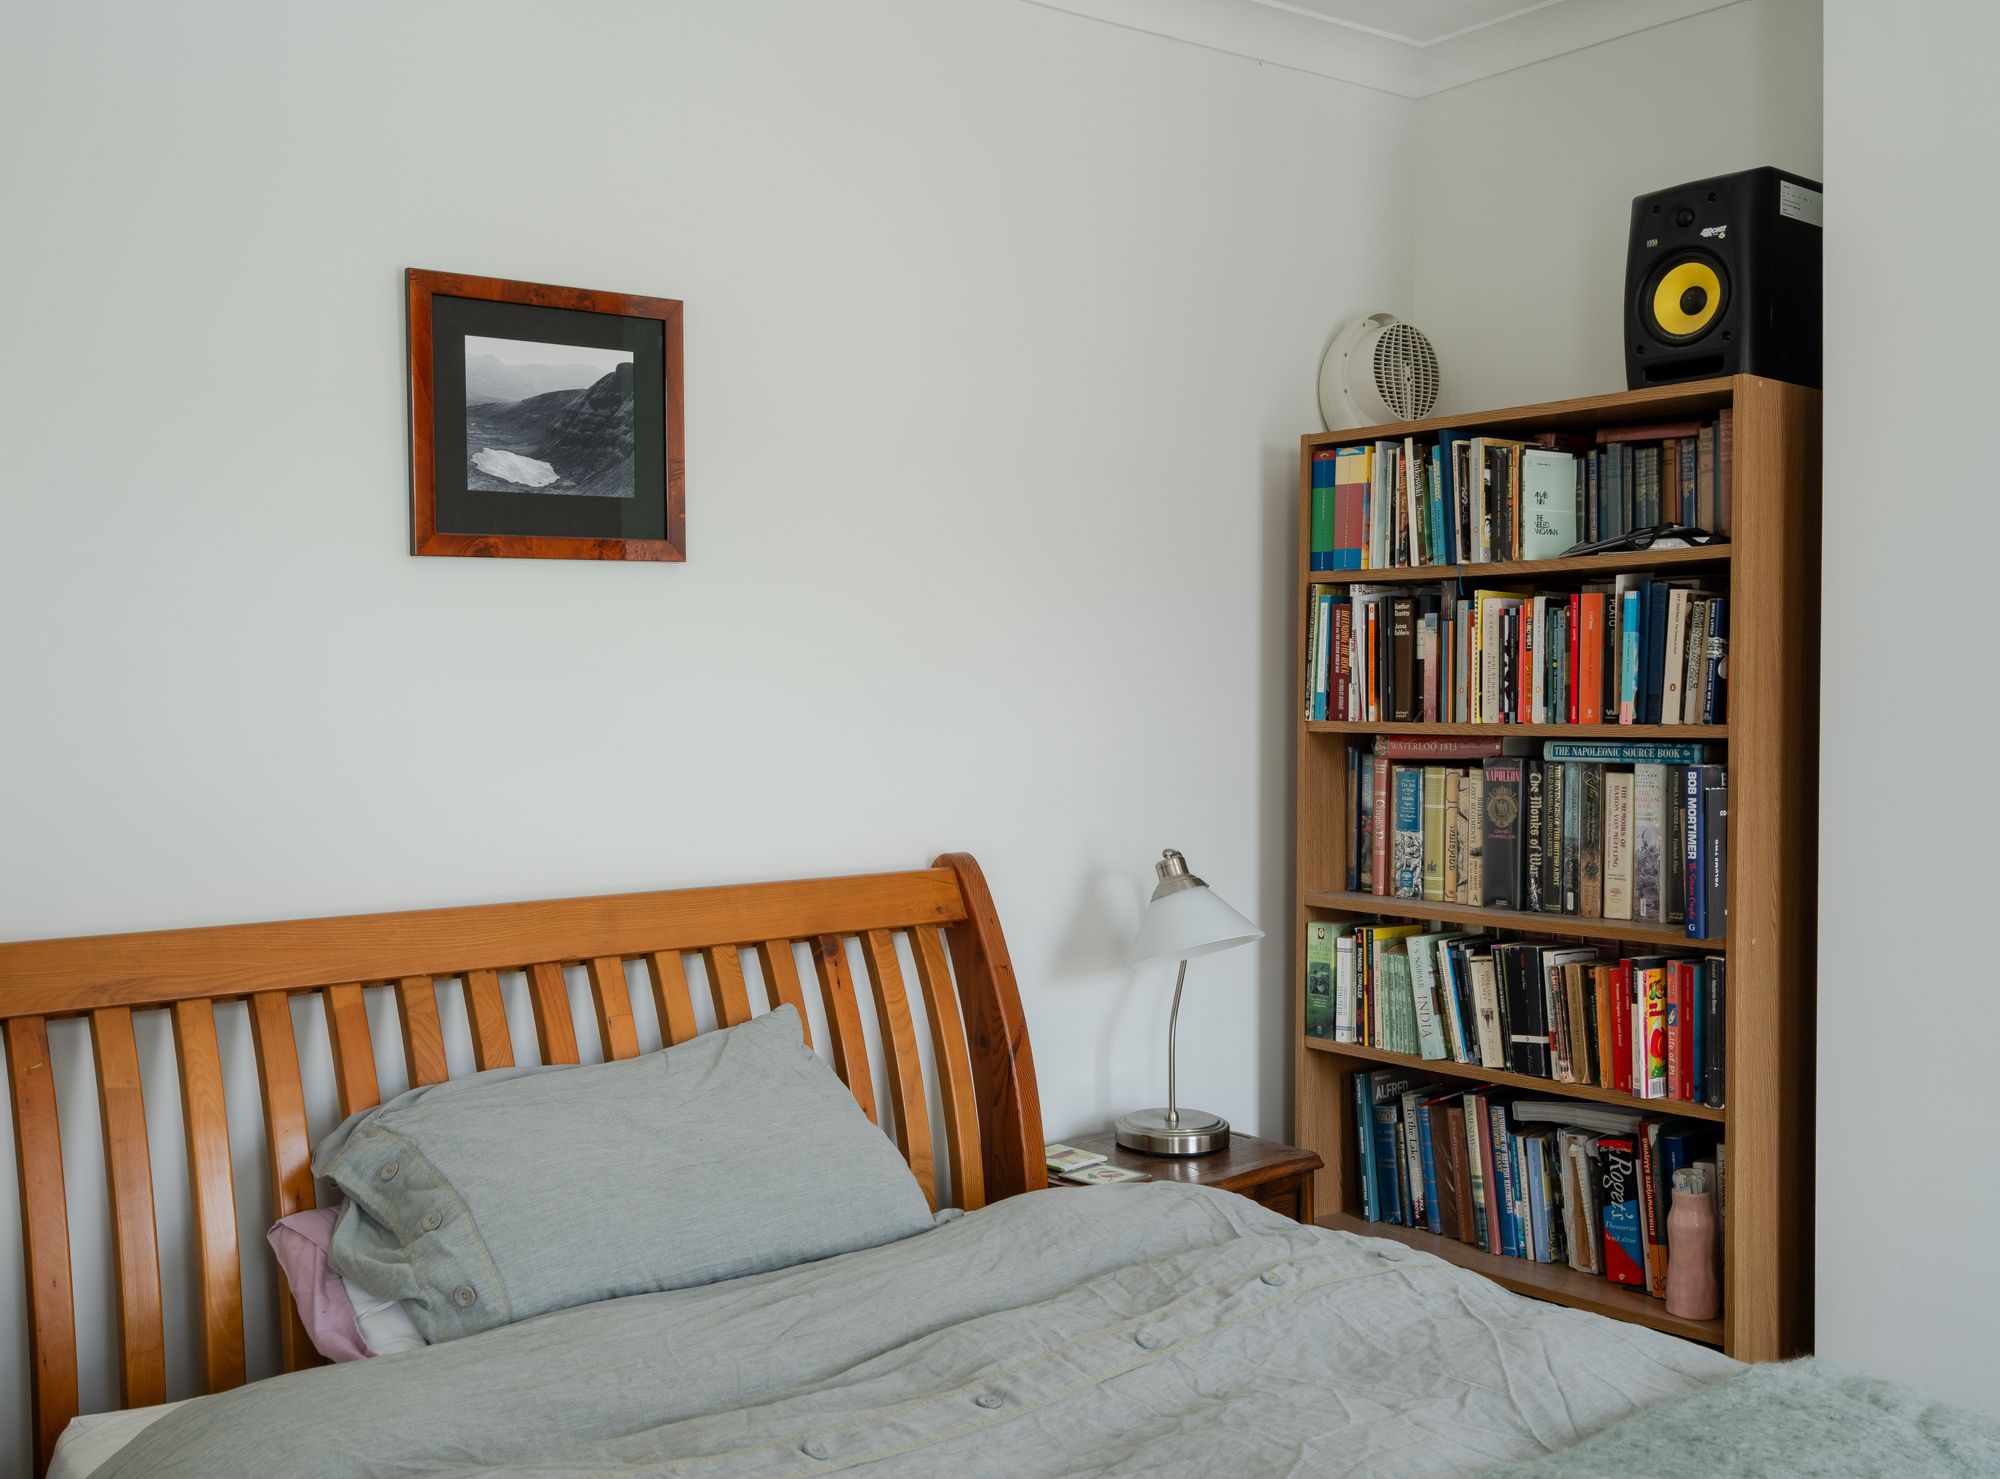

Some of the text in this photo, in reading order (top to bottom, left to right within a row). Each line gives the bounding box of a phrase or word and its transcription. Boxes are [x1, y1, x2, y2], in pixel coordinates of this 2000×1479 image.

[1414, 459, 1423, 497] Bukowski
[1534, 528, 1558, 536] WOMAN
[1340, 610, 1350, 675] DEFENDING THE ROCK
[1391, 743, 1437, 751] WATERLOO
[1440, 742, 1457, 751] 1815
[1554, 746, 1680, 759] THE NAPOLEONIC SOURCE BOOK
[1485, 770, 1520, 782] NAPOLEON
[1688, 771, 1697, 795] BOB
[1530, 772, 1542, 877] The Monks of War
[1688, 798, 1697, 859] MORTIMER
[1415, 957, 1424, 988] NAIPAUL
[1418, 996, 1432, 1038] INDIA
[1376, 1080, 1408, 1100] ALFRED
[1407, 1107, 1415, 1118] To
[1465, 1099, 1476, 1146] DOMESDAY
[1498, 1110, 1507, 1146] HANDBOOK
[1491, 1109, 1500, 1150] CHRISTOPHER
[1409, 1139, 1418, 1160] Lake
[1502, 1154, 1511, 1178] BRITISH
[1504, 1179, 1512, 1214] REGIMENTS
[1603, 1153, 1634, 1220] Roget's
[1642, 1138, 1655, 1235] επικοινωνήστε ελληνικά
[1605, 1221, 1637, 1232] Thesaurus
